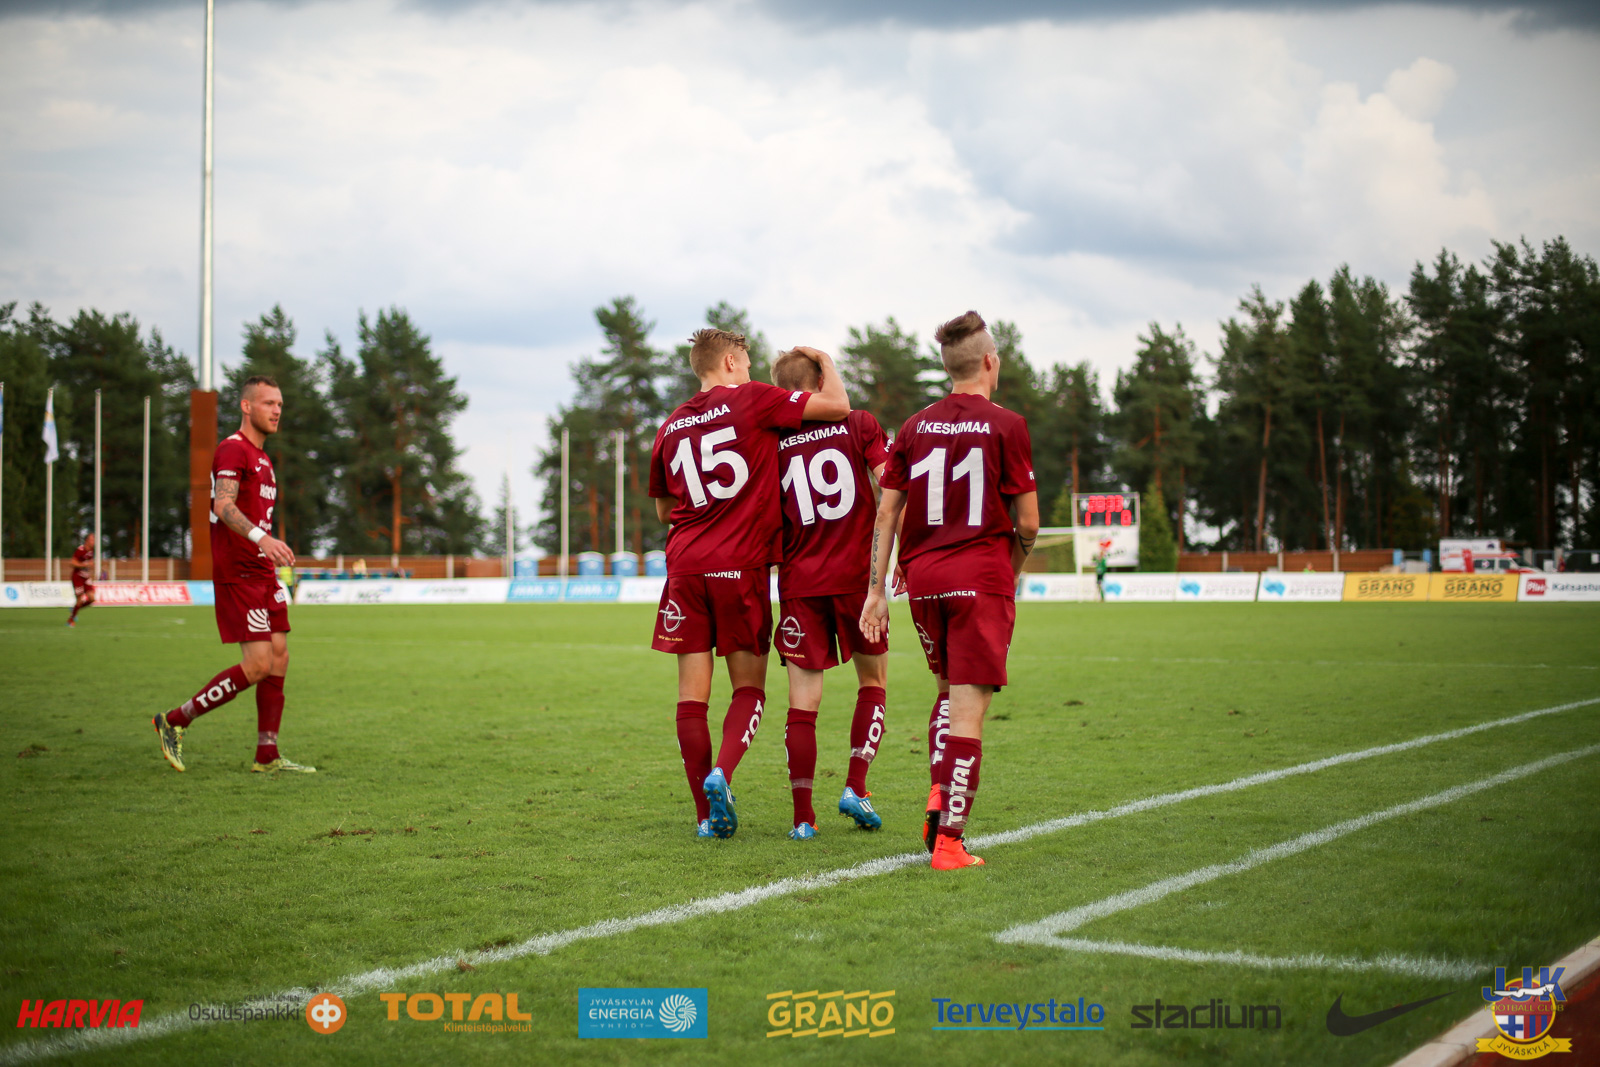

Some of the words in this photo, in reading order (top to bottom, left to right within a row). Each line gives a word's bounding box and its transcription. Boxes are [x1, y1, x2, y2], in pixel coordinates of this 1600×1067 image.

[670, 404, 730, 433] KESKIMAA
[924, 421, 990, 435] KESKIMAA
[780, 425, 848, 450] KESKIMAA
[669, 426, 749, 509] 15
[781, 448, 856, 526] 19
[910, 447, 984, 526] 11
[151, 586, 184, 602] LINE
[1357, 581, 1415, 593] GRANO
[1444, 581, 1503, 594] GRANO
[196, 677, 237, 708] TOT
[861, 704, 886, 756] TOT
[946, 755, 976, 827] TOTAL
